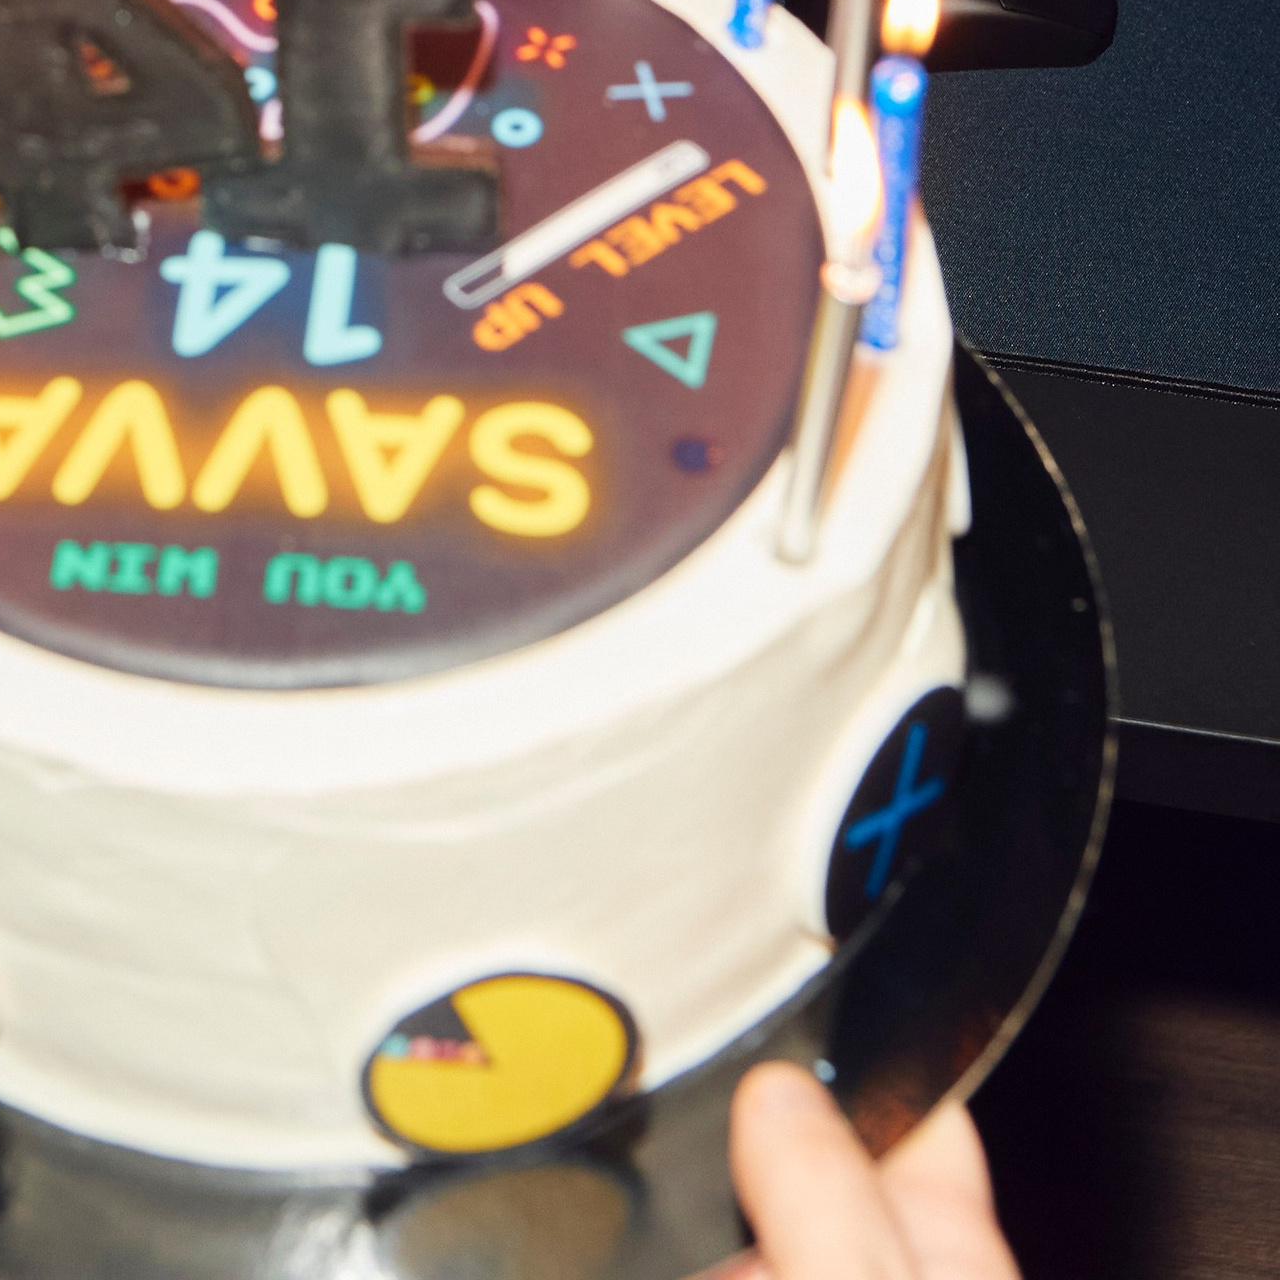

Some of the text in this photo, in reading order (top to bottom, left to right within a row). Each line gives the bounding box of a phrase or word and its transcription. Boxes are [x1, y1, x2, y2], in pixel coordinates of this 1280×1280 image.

[159, 229, 383, 367] 14
[472, 158, 767, 352] LEVEL UP
[50, 540, 426, 614] YOU WIN
